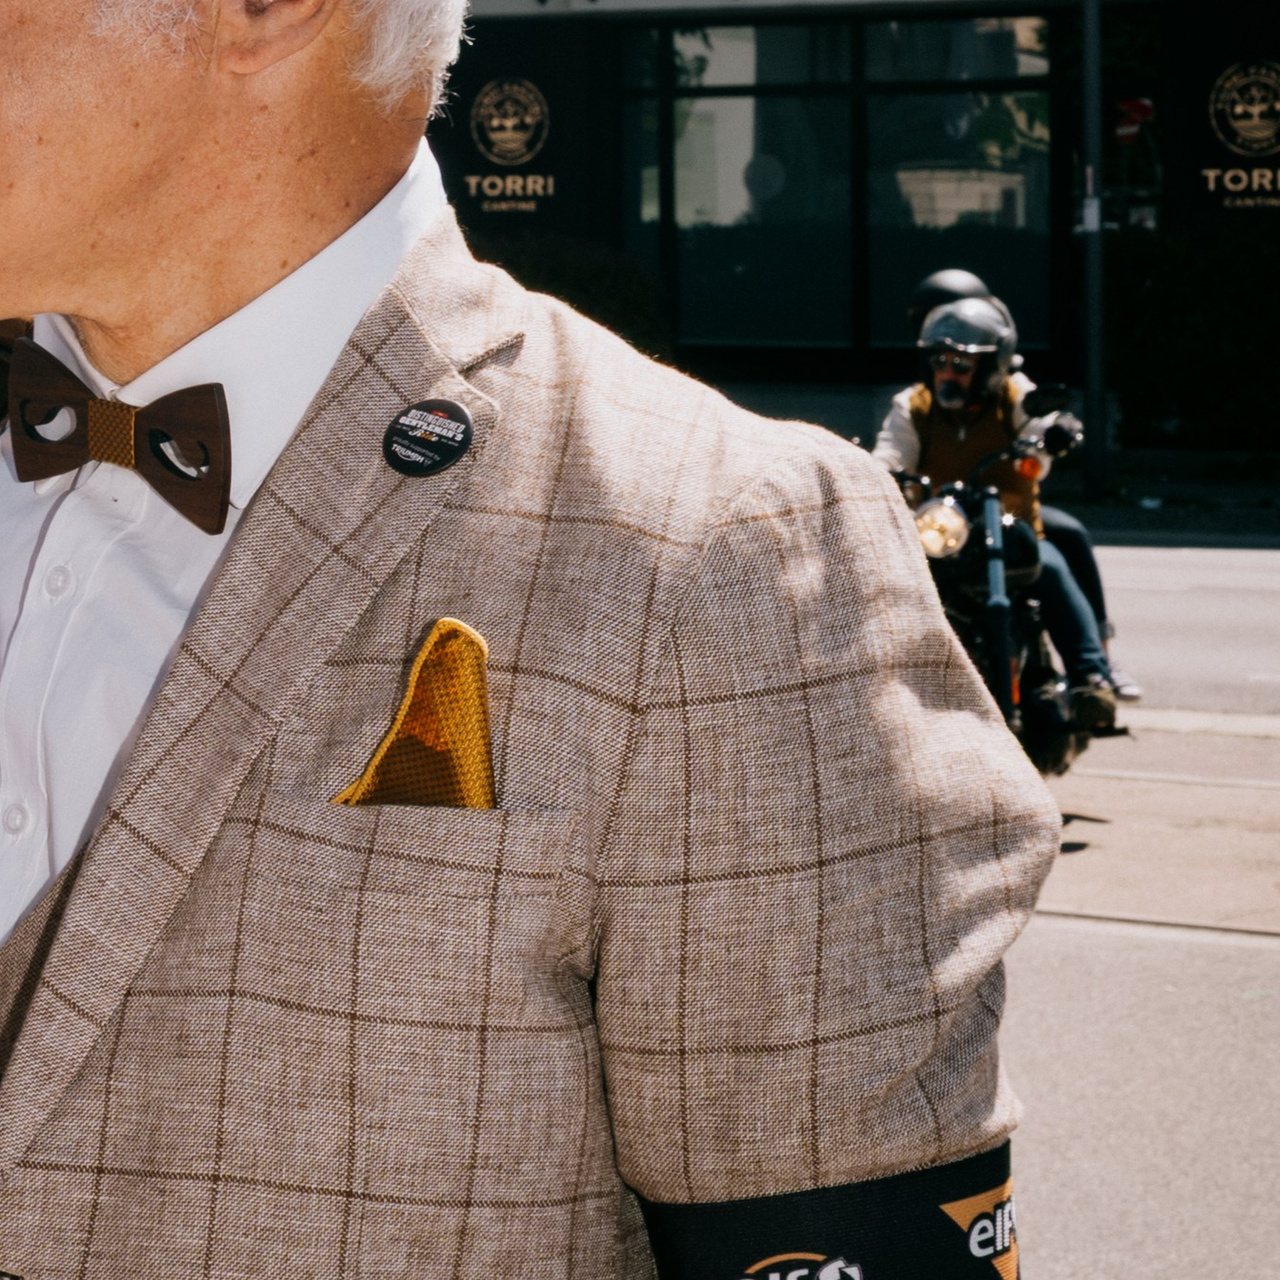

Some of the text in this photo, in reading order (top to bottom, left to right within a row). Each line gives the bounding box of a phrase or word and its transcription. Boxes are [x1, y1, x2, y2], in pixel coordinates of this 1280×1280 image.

[464, 175, 554, 197] TORRI
[1201, 169, 1280, 192] TOR
[1223, 197, 1280, 208] CANTIN
[399, 416, 464, 441] GENTLEMAN'S
[407, 409, 466, 433] DISTINGUISHED
[408, 428, 439, 442] Ride
[391, 443, 425, 463] TRIUMPH
